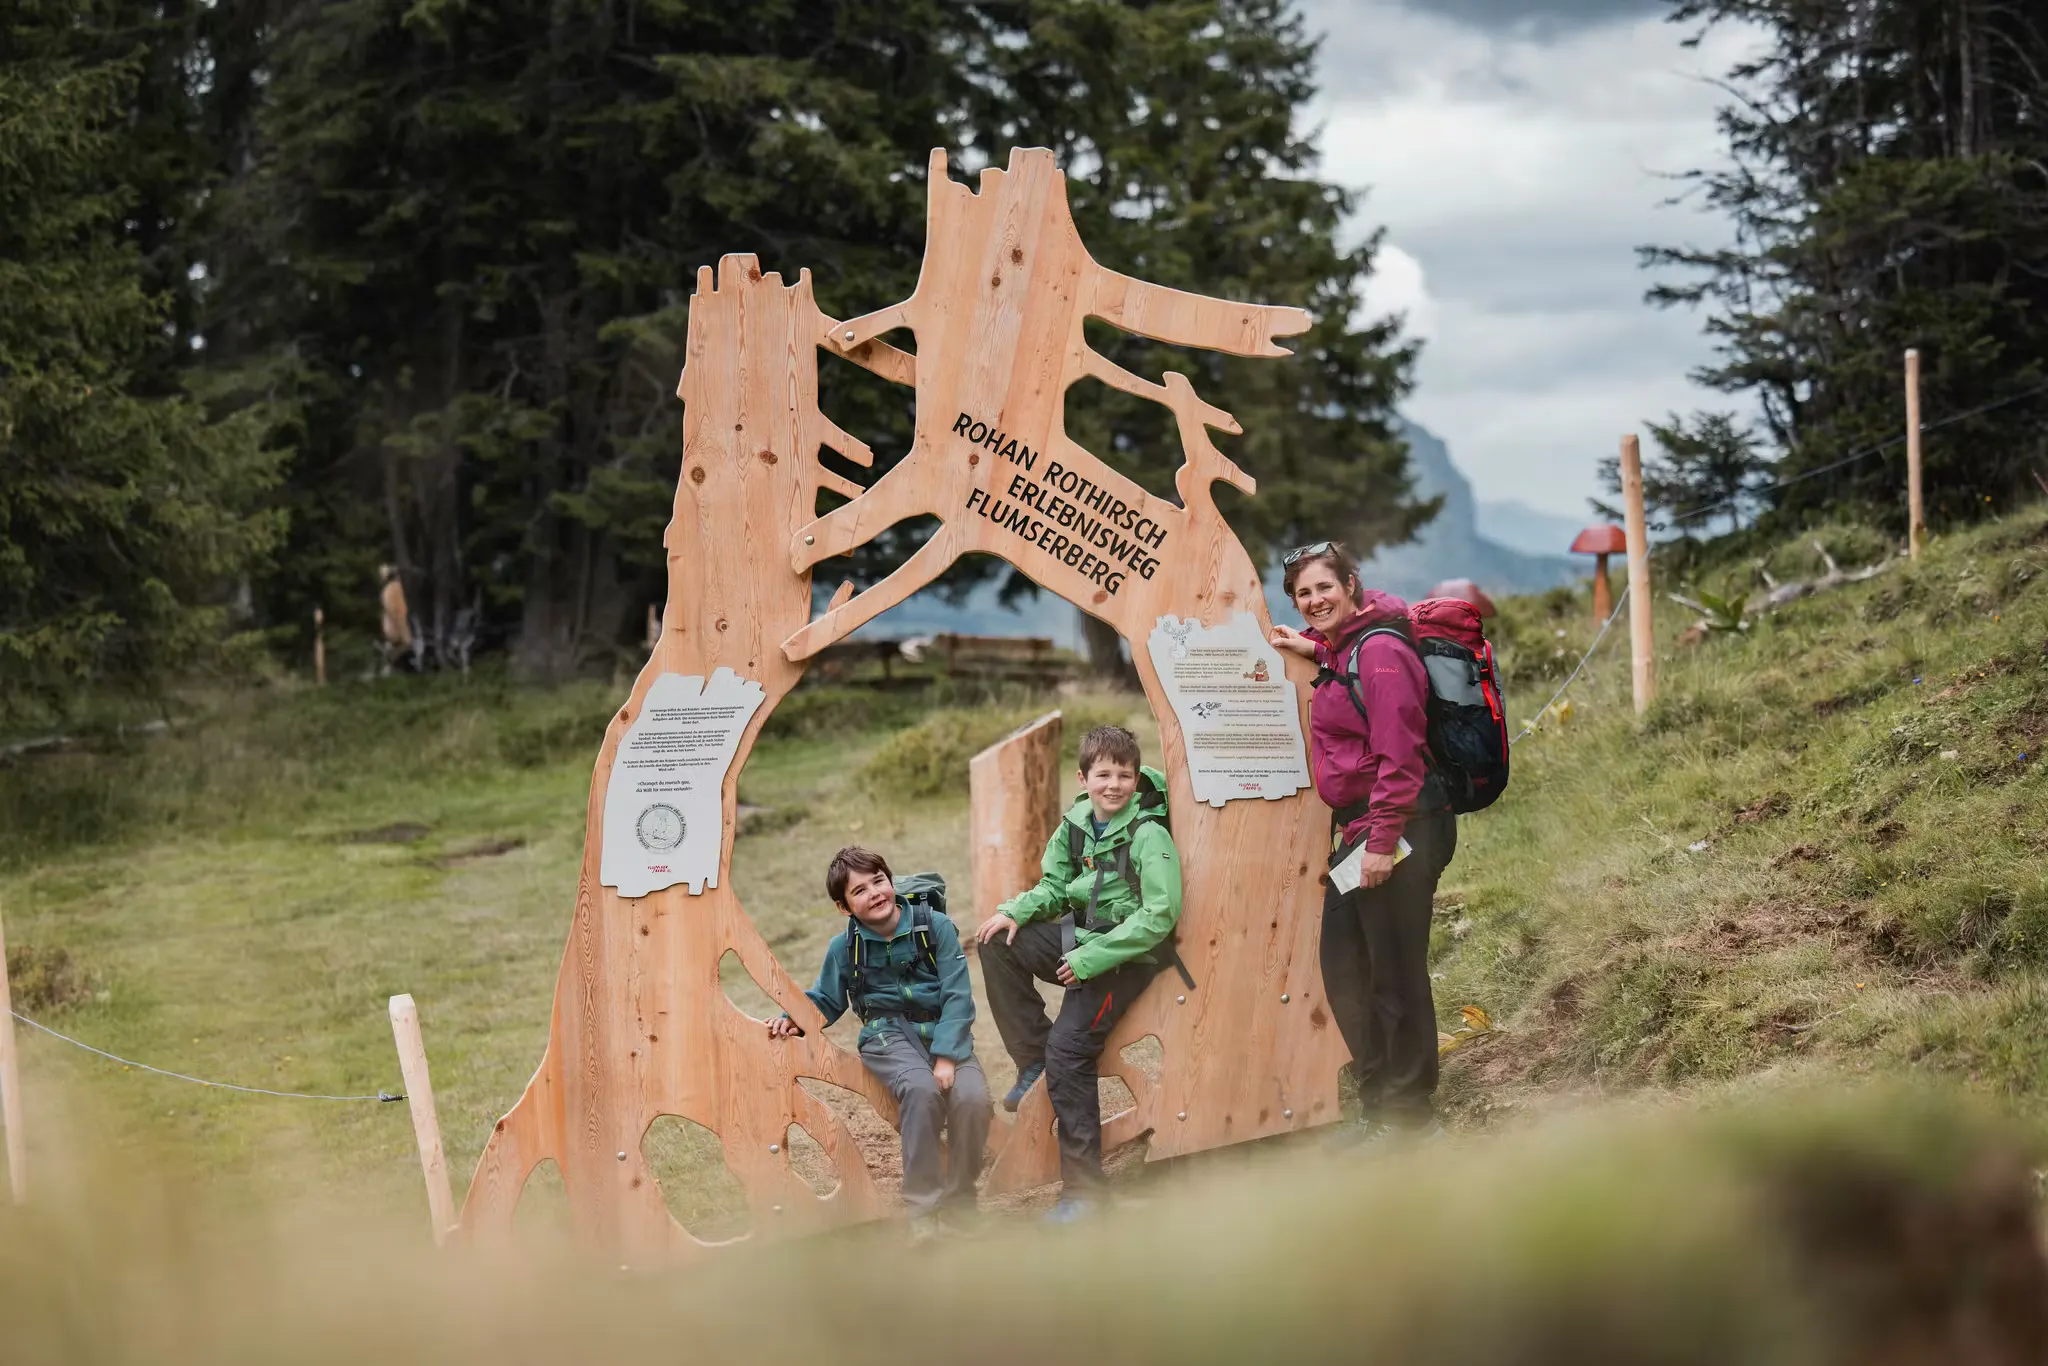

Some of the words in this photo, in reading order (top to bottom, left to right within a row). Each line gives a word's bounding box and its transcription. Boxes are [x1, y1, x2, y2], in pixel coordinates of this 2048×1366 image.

[952, 412, 1039, 472] ROHAN
[1043, 461, 1168, 549] ROTHIRSCH
[1007, 474, 1160, 581] ERLEBNISWEG
[966, 488, 1126, 596] FLUMSERBERG
